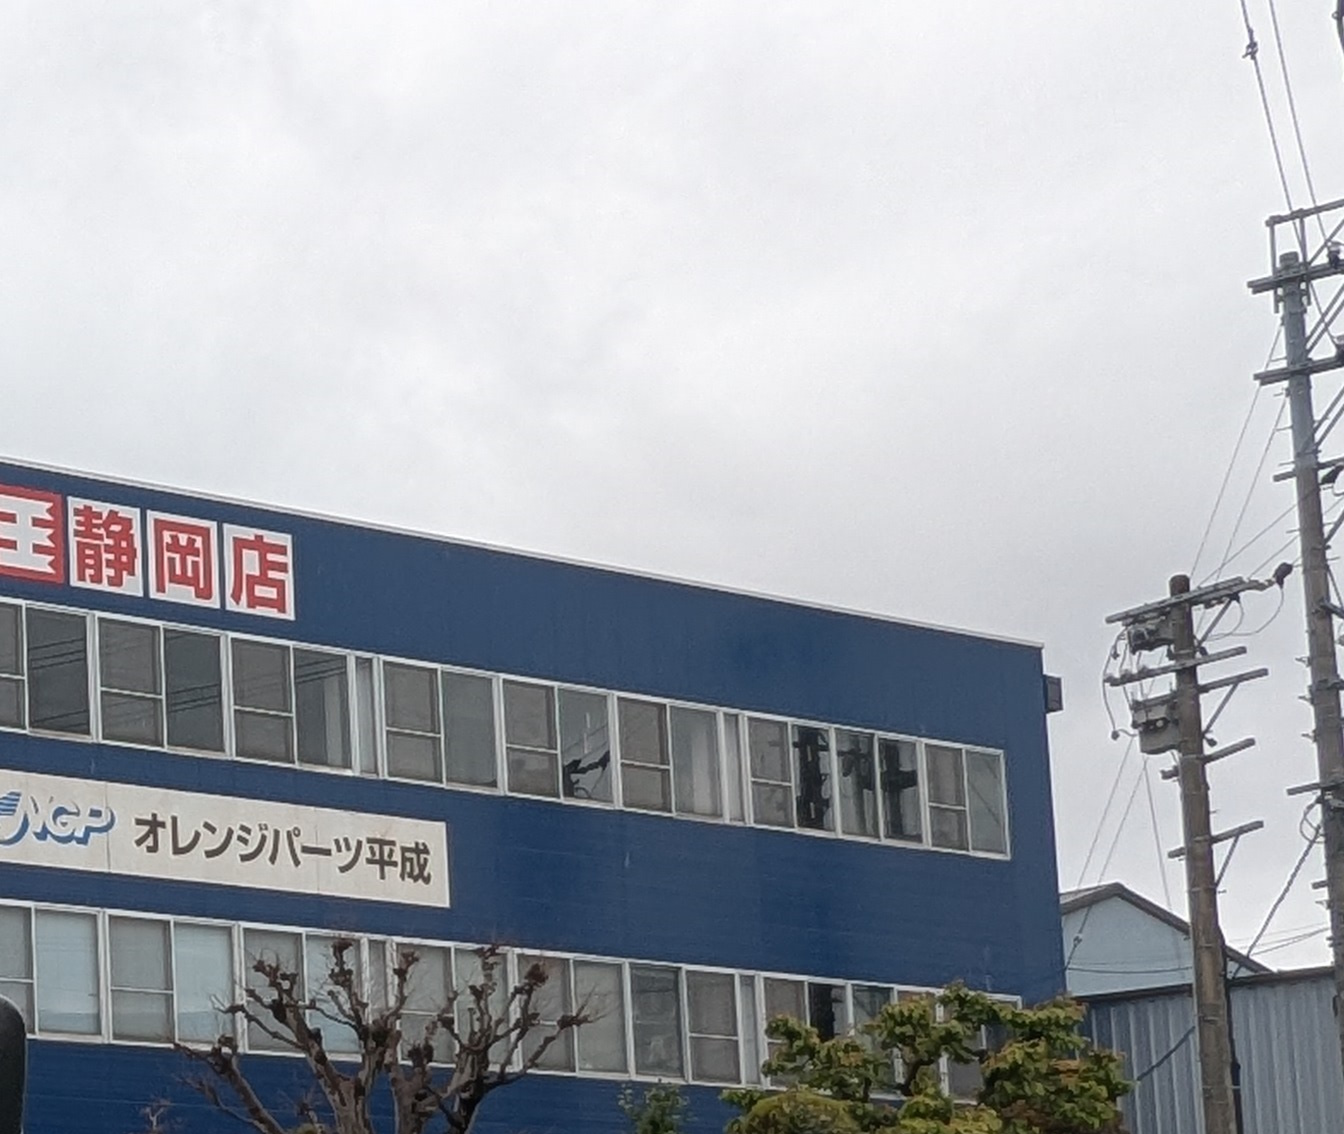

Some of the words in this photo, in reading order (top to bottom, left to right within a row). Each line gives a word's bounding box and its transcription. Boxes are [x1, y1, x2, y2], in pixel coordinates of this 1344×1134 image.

[134, 812, 433, 886] オレンジパーツ平成
